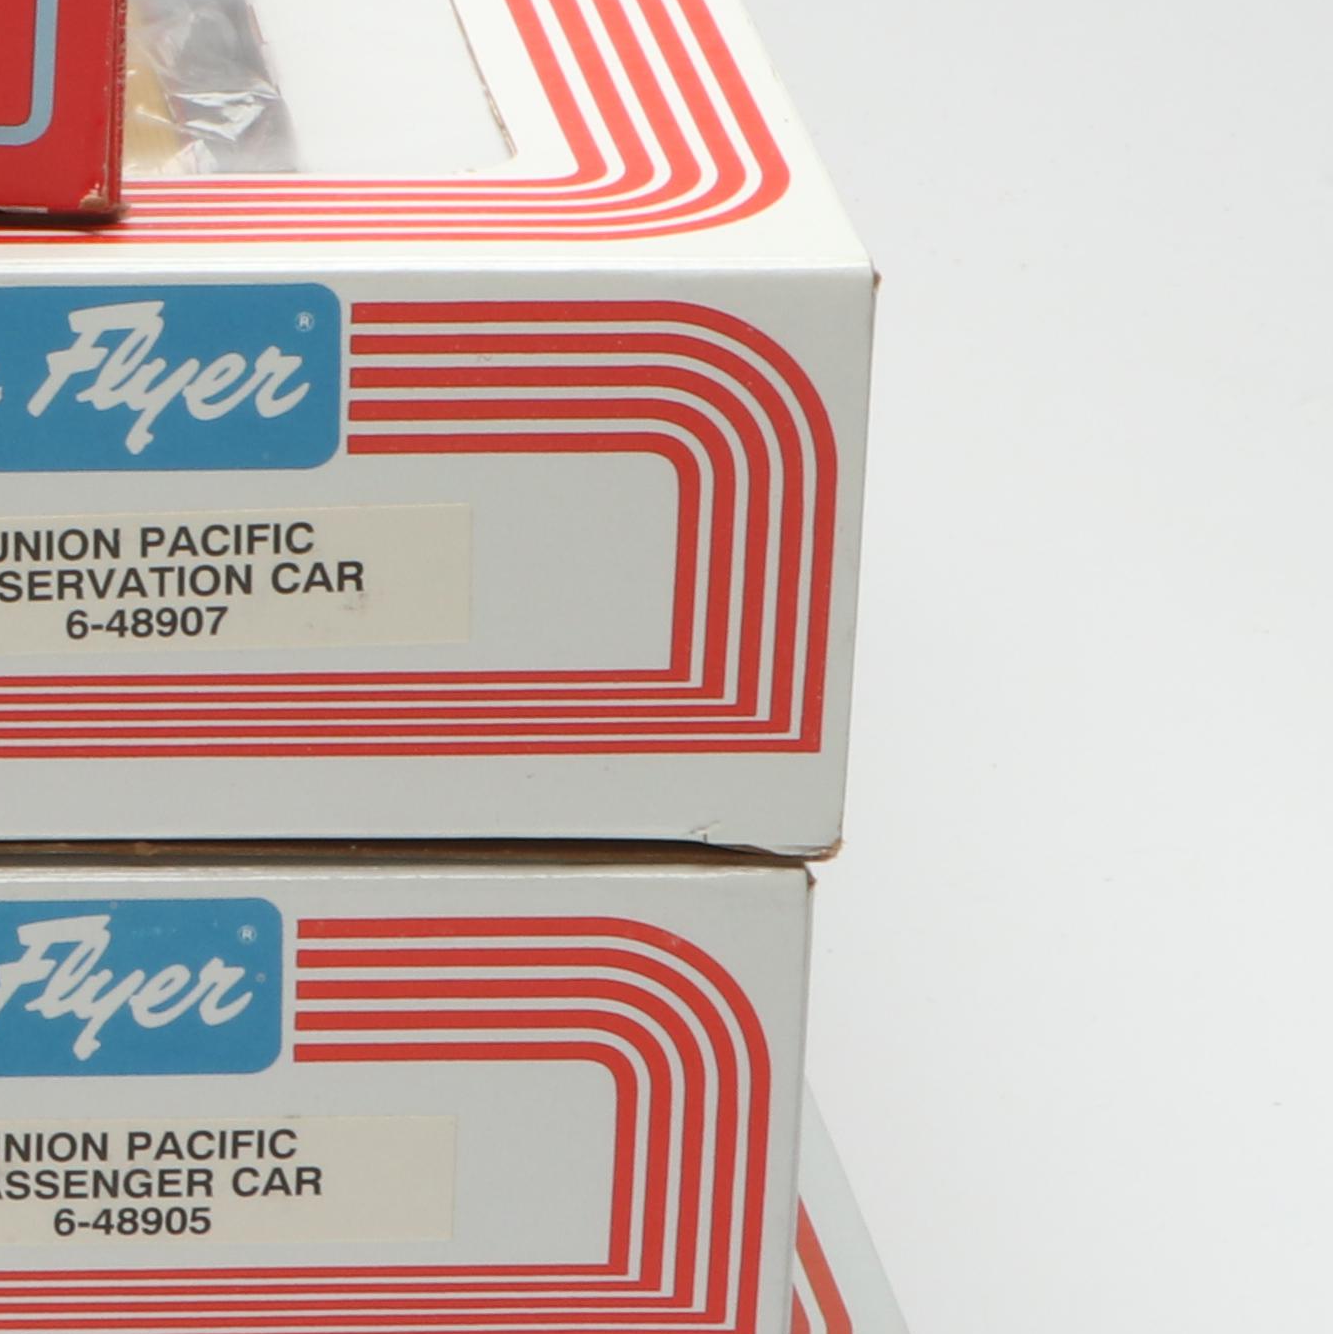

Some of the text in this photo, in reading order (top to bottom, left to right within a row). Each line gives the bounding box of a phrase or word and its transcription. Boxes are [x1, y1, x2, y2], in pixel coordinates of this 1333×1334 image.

[141, 522, 315, 559] PACIFIC
[272, 561, 365, 596] CAR
[67, 607, 229, 641] 6-48907
[128, 1129, 298, 1162] PACIFIC
[233, 1167, 323, 1198] CAR
[55, 1207, 212, 1238] 6-48905
